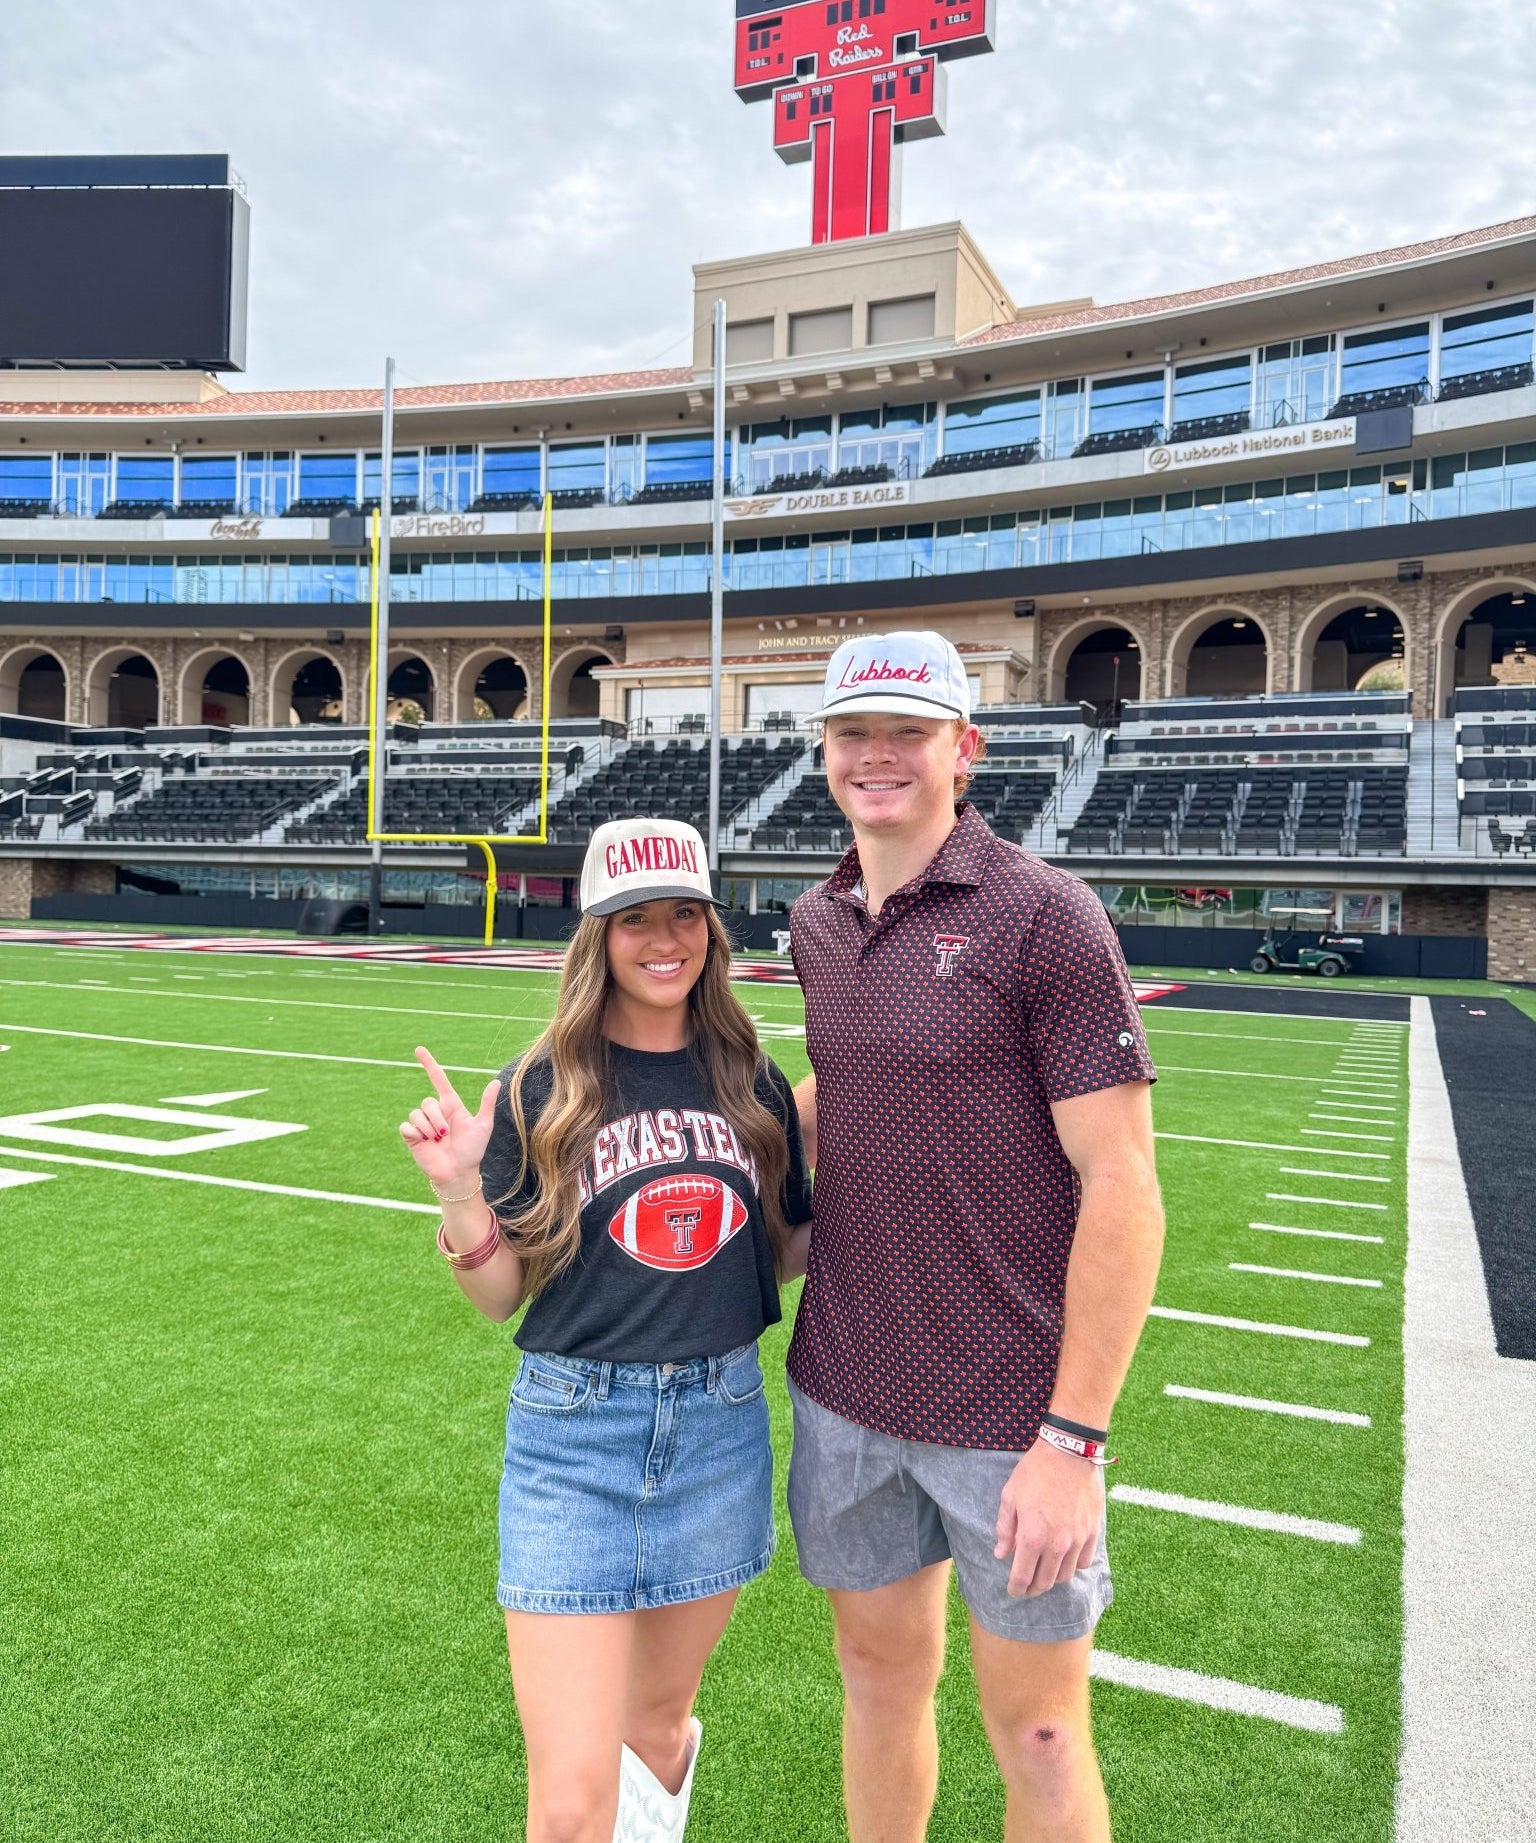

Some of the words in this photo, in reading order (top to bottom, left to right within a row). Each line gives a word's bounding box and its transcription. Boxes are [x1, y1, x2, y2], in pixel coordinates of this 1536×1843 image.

[837, 23, 874, 45] Red
[828, 45, 883, 67] Raiders
[1174, 442, 1239, 463] Lubbock
[1242, 430, 1306, 453] National
[1311, 424, 1353, 442] Bank
[786, 490, 848, 512] DOUBLE
[852, 486, 905, 505] EAGLE
[758, 638, 784, 650] JOHN
[786, 636, 807, 648] AND
[809, 634, 841, 647] TRACY
[836, 655, 932, 690] Lubbock
[605, 836, 699, 879] GAMEDAY
